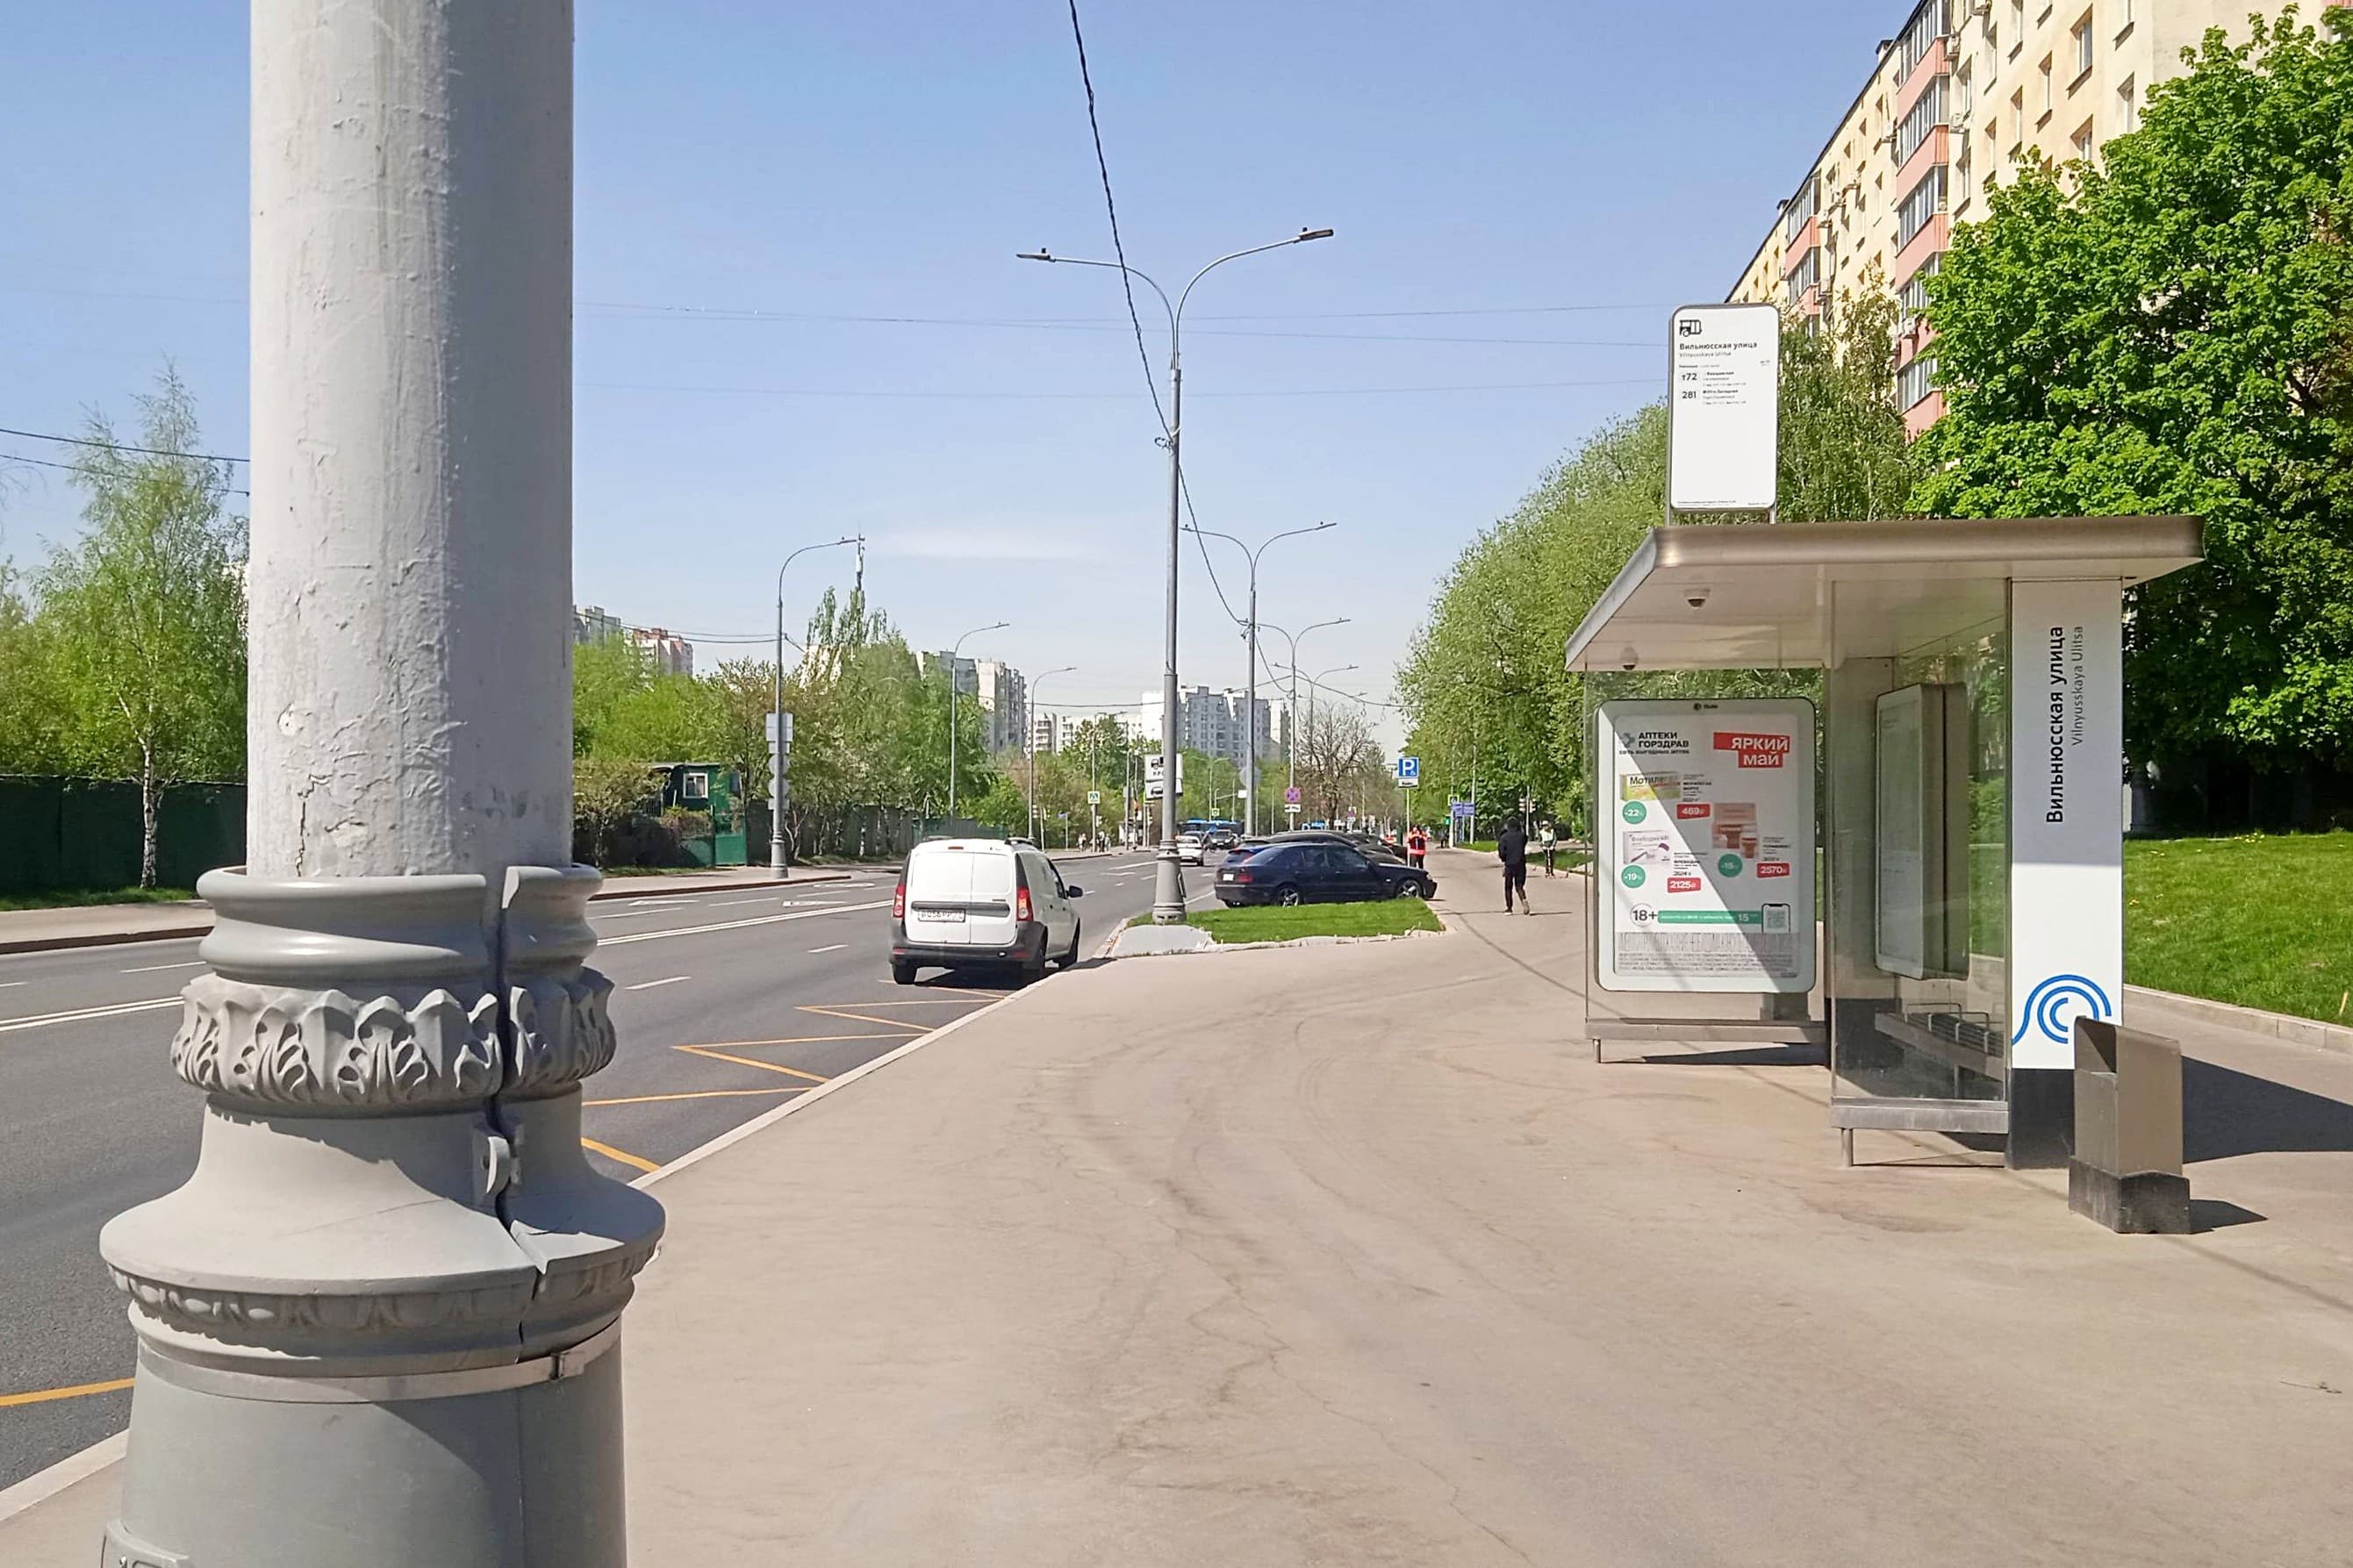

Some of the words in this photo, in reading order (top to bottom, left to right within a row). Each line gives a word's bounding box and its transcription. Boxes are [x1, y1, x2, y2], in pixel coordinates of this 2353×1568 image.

[2050, 626, 2066, 685] улица
[2071, 626, 2084, 662] Ulitsa
[2071, 665, 2085, 746] Vilnyusskaya
[1639, 740, 1689, 748] ГОРЗДРАВ
[1732, 736, 1789, 751] ЯРКИЙ
[2046, 691, 2063, 823] Вильнюсская
[1632, 910, 1658, 921] 18+
